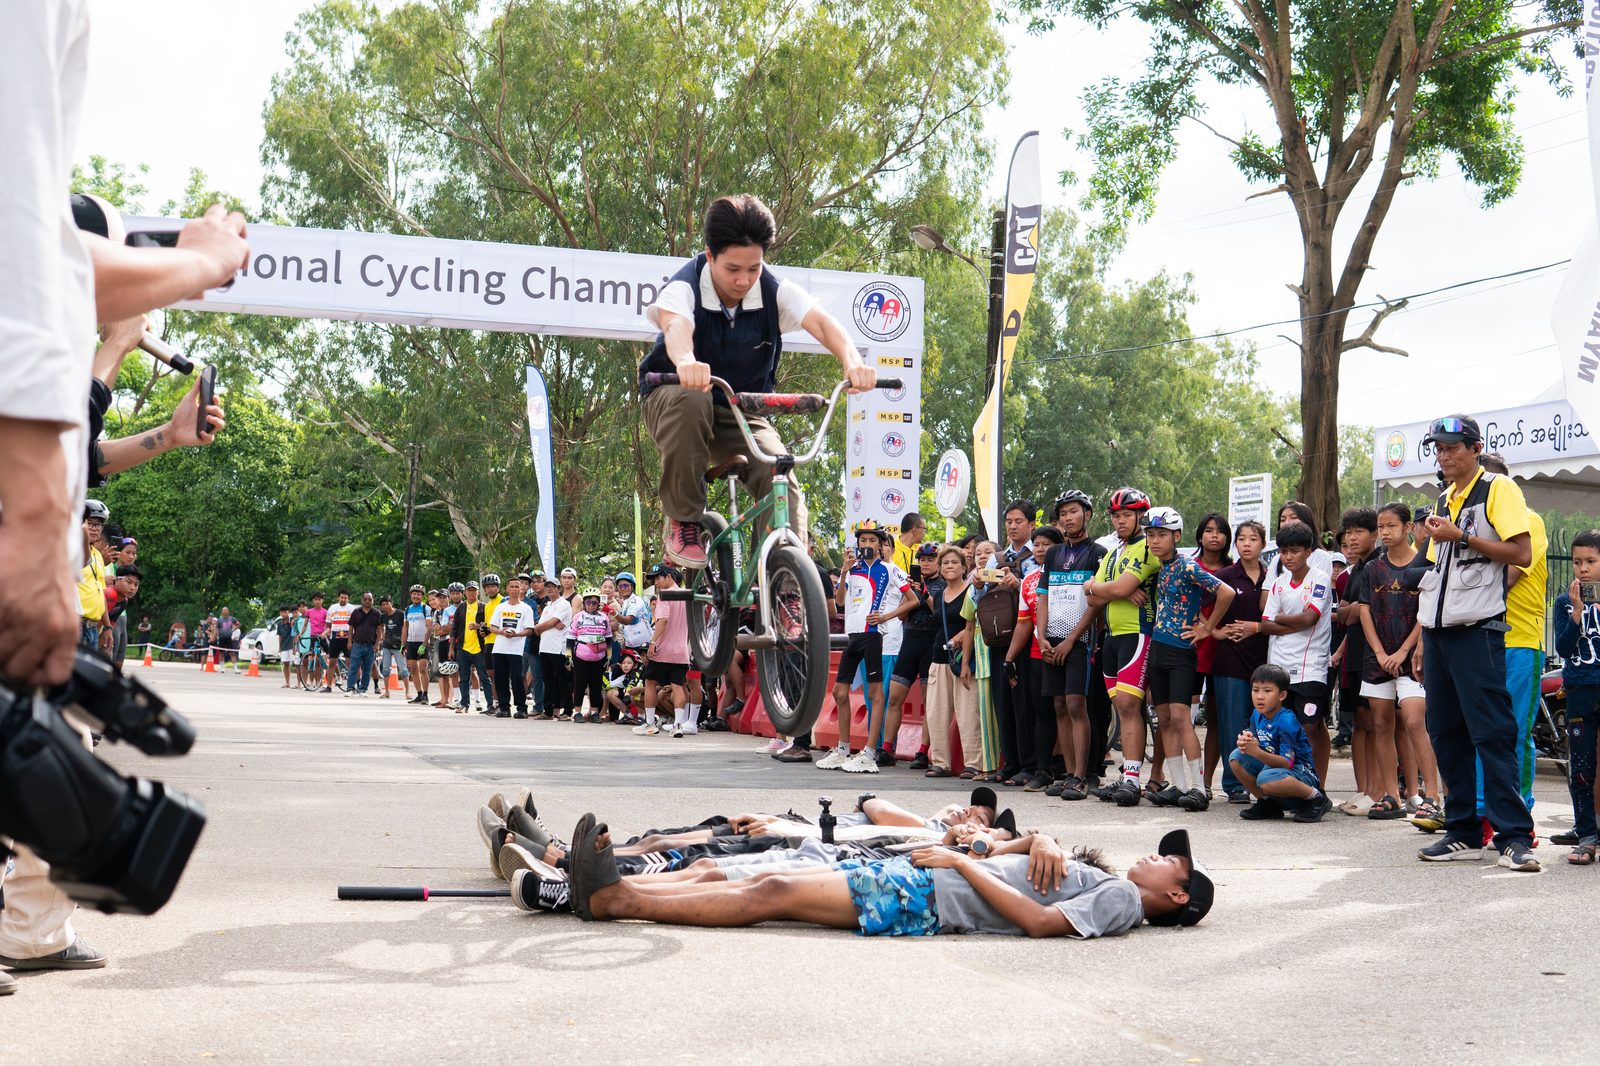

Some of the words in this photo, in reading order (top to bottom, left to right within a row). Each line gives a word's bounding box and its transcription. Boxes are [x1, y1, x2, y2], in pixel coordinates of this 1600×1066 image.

[1013, 216, 1039, 267] CAT
[360, 254, 506, 304] Cycling
[522, 266, 669, 316] Champ
